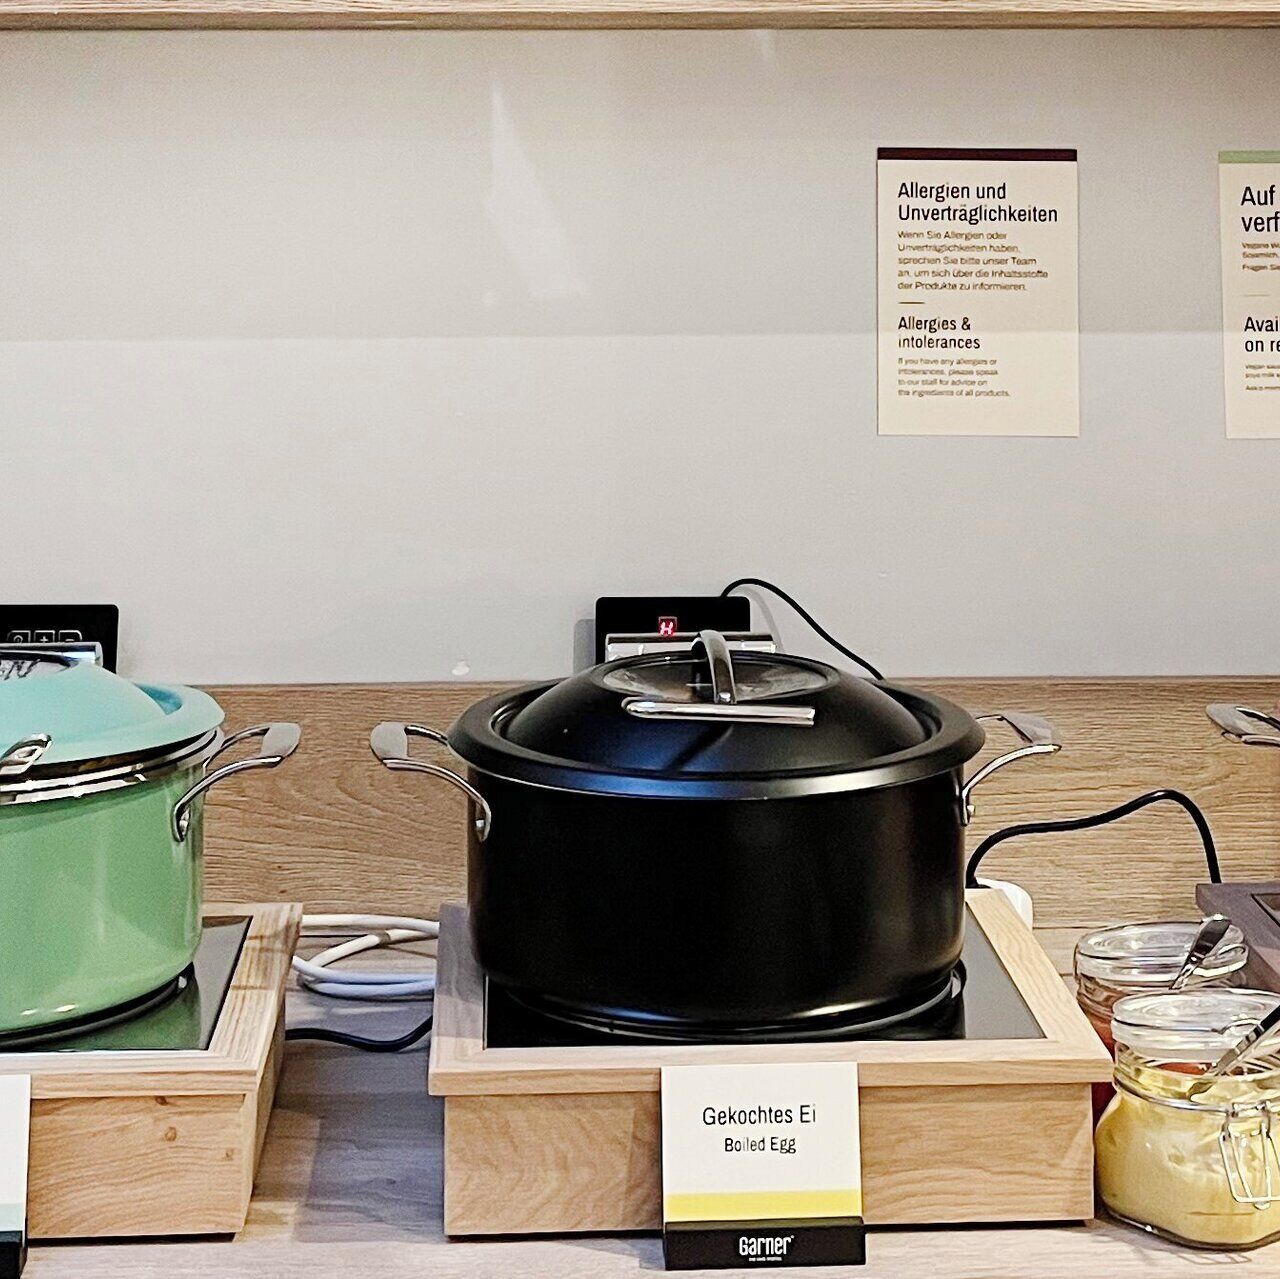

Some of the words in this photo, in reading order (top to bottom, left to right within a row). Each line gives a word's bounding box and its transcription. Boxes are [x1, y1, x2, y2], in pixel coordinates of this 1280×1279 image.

[898, 182, 970, 202] Allergien
[976, 182, 1007, 199] und
[1241, 184, 1276, 206] Auf
[898, 204, 1058, 225] Unverträglichkeiten
[927, 231, 941, 239] Sie
[943, 256, 958, 265] Sie
[1011, 256, 1036, 265] Team
[898, 316, 957, 333] Allergies
[961, 317, 971, 330] &
[898, 335, 981, 349] intolerances
[1245, 340, 1264, 352] on
[702, 1106, 793, 1126] Gekochtes
[799, 1104, 816, 1123] Ei
[724, 1137, 766, 1152] Boiled
[770, 1136, 797, 1153] Egg
[739, 1236, 792, 1256] Garner
